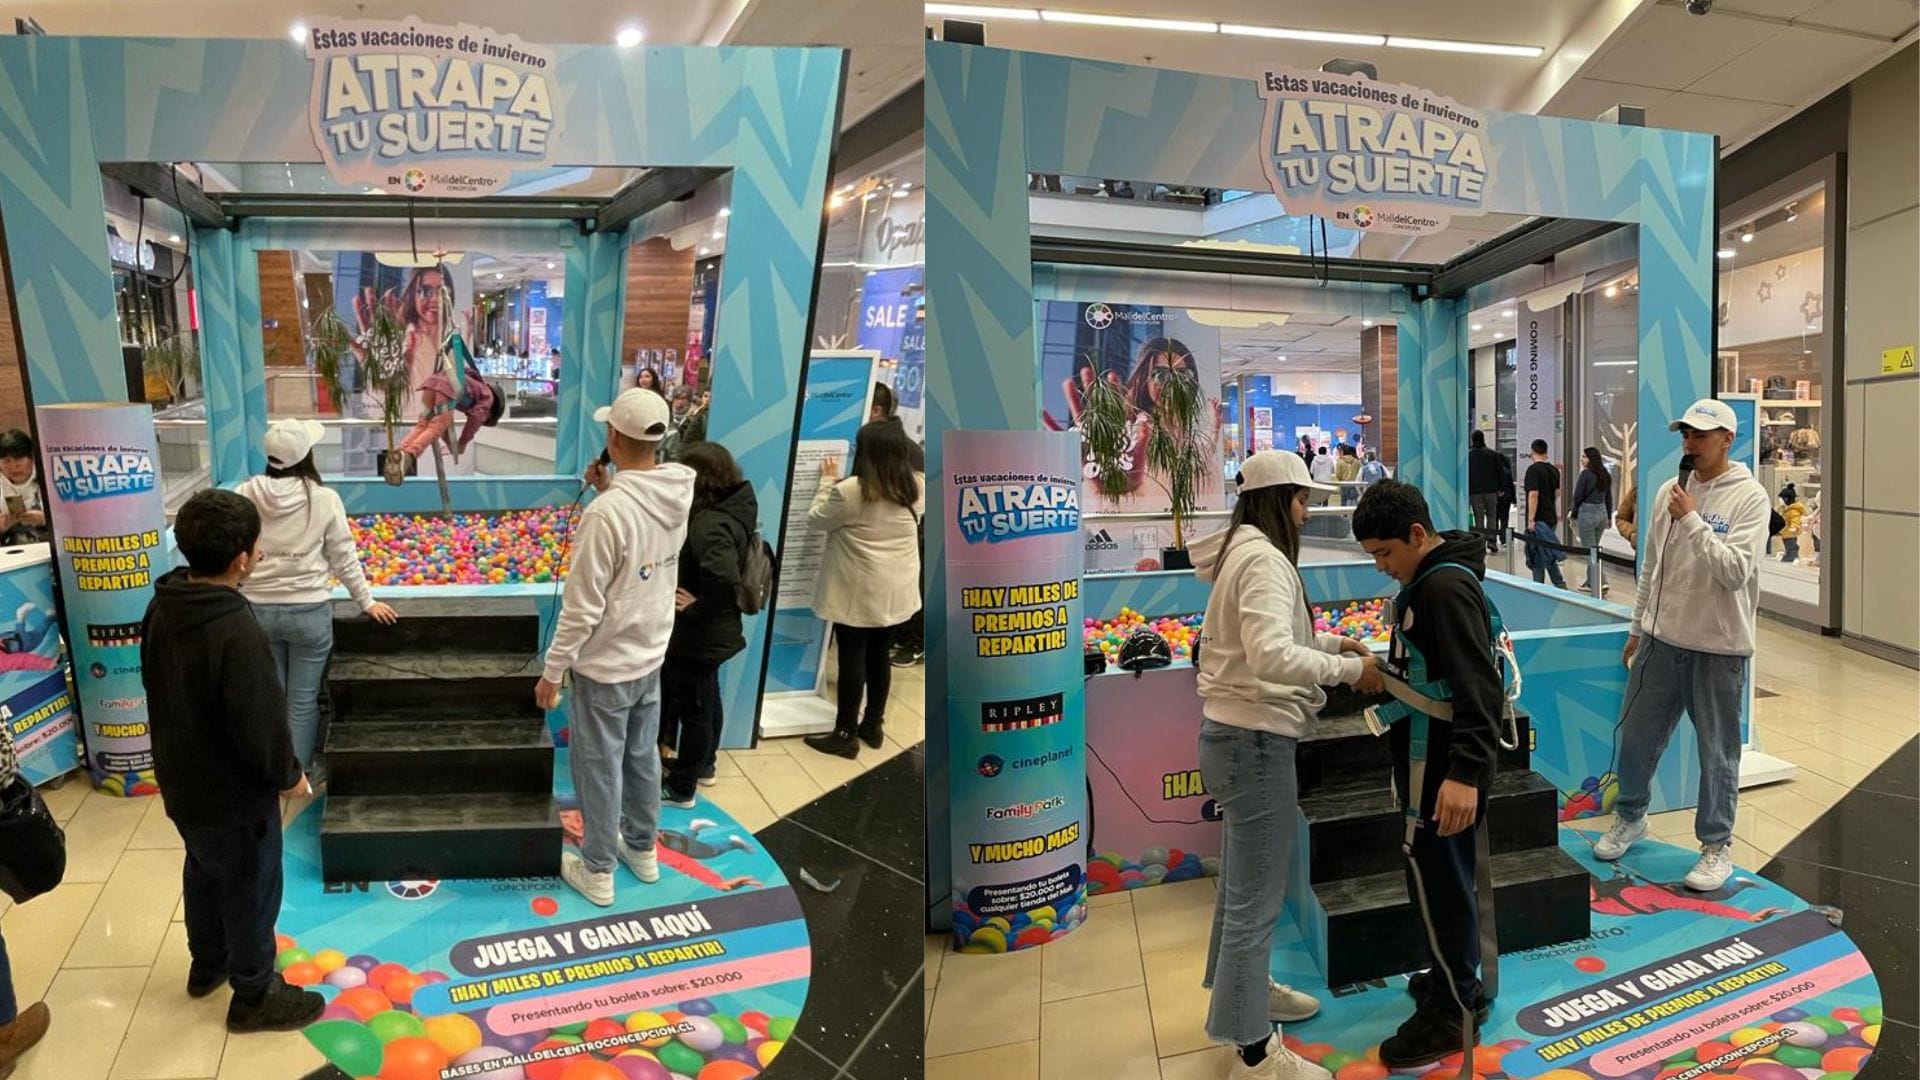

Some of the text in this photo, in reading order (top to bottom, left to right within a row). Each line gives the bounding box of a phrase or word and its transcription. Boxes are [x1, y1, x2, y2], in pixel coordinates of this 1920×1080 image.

[313, 27, 546, 68] Estas vacaciones de invierno
[325, 54, 552, 122] ATRAPA
[1265, 72, 1479, 129] Estas vacaciones de invierno
[330, 111, 550, 158] TU SUERTE
[1275, 99, 1487, 173] ATRAPA
[388, 177, 401, 185] EN
[1280, 154, 1483, 201] TU SUERTE
[866, 305, 909, 329] SALE
[1529, 320, 1539, 411] COMING SOON
[53, 455, 154, 481] ATRAPA
[954, 473, 977, 485] Estas
[980, 471, 1035, 482] vacaciones
[1037, 473, 1047, 482] de
[56, 474, 154, 496] TU SUERTE
[960, 486, 1079, 518] ATRAPA
[964, 510, 1078, 535] TU SUERTE
[96, 534, 140, 552] MILES
[141, 530, 159, 548] DE
[73, 552, 149, 573] PREMIOS A
[78, 571, 149, 591] REPARTIR!
[962, 579, 1078, 608] ¡HAY MILES DE
[973, 606, 1068, 633] PREMIOS A
[977, 629, 1066, 657] REPARTIR!
[988, 700, 1059, 718] RIPLEY
[100, 723, 147, 737] MUCHO
[1012, 745, 1074, 770] cineplanet
[1163, 770, 1208, 800] ¡HA
[986, 796, 1063, 821] Family Park
[969, 822, 1080, 864] Y MUCHO MAS!
[983, 883, 1037, 897] Presentando
[1038, 879, 1047, 888] tu
[991, 896, 1018, 904] sobre:
[1019, 886, 1055, 901] $20.000
[980, 902, 1019, 914] cualquier
[1020, 897, 1046, 908] tienda
[473, 904, 712, 969] JUEGA Y GANA AQUÍ
[450, 941, 725, 1003] ¡HAY MILES DE PREMIOS A REPARTIR!
[1542, 937, 1764, 1028] JUEGA Y GANA AQUÍ
[511, 971, 742, 1023] Presentando tu boleta sobre: $20.000
[1537, 961, 1788, 1061] ¡HAY MILES DE PREMIOS A REPARTIR!
[1615, 981, 1816, 1064] Presentando tu boleta sobre: $20.000
[441, 1021, 695, 1080] BASES EN MALLDELCENTROCONCEPCION.CL
